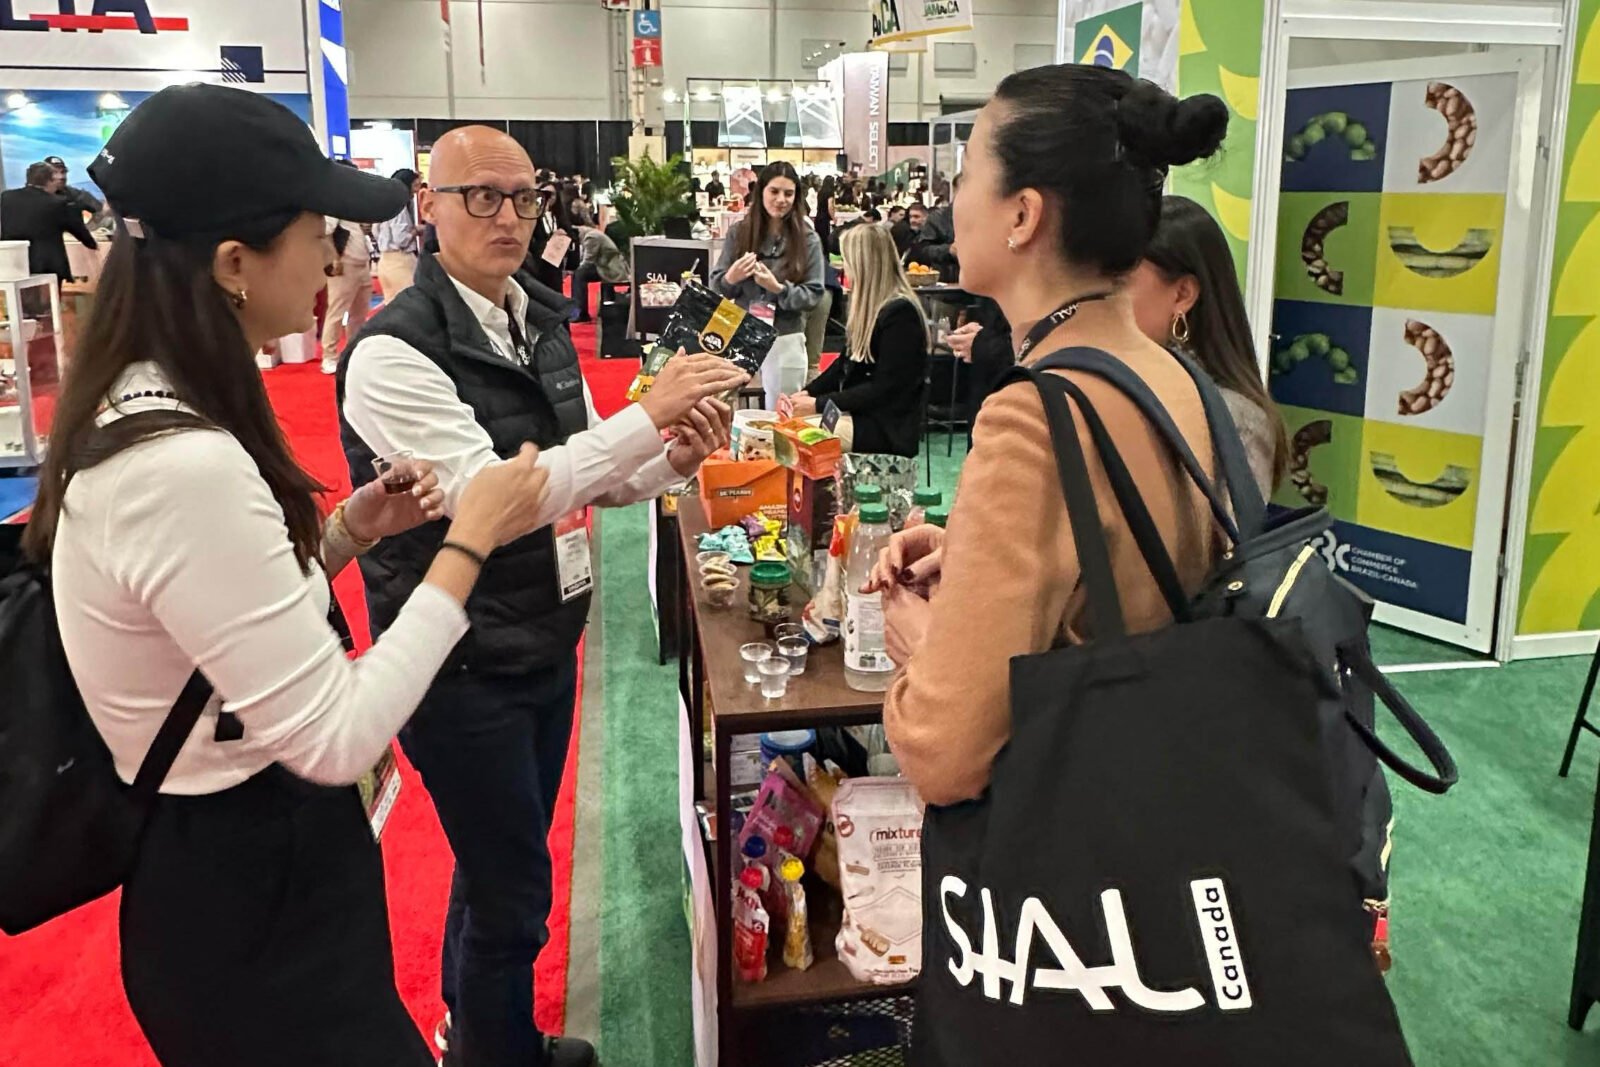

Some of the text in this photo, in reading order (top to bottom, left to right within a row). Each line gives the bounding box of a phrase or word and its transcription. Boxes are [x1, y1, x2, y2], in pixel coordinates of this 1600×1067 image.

[868, 121, 880, 171] SELECT
[1351, 547, 1406, 566] CHAMBER OF
[1351, 556, 1399, 574] COMMERCE
[1351, 565, 1418, 588] BRAZIL-CANADA
[940, 875, 1243, 1012] SIAL Canada
